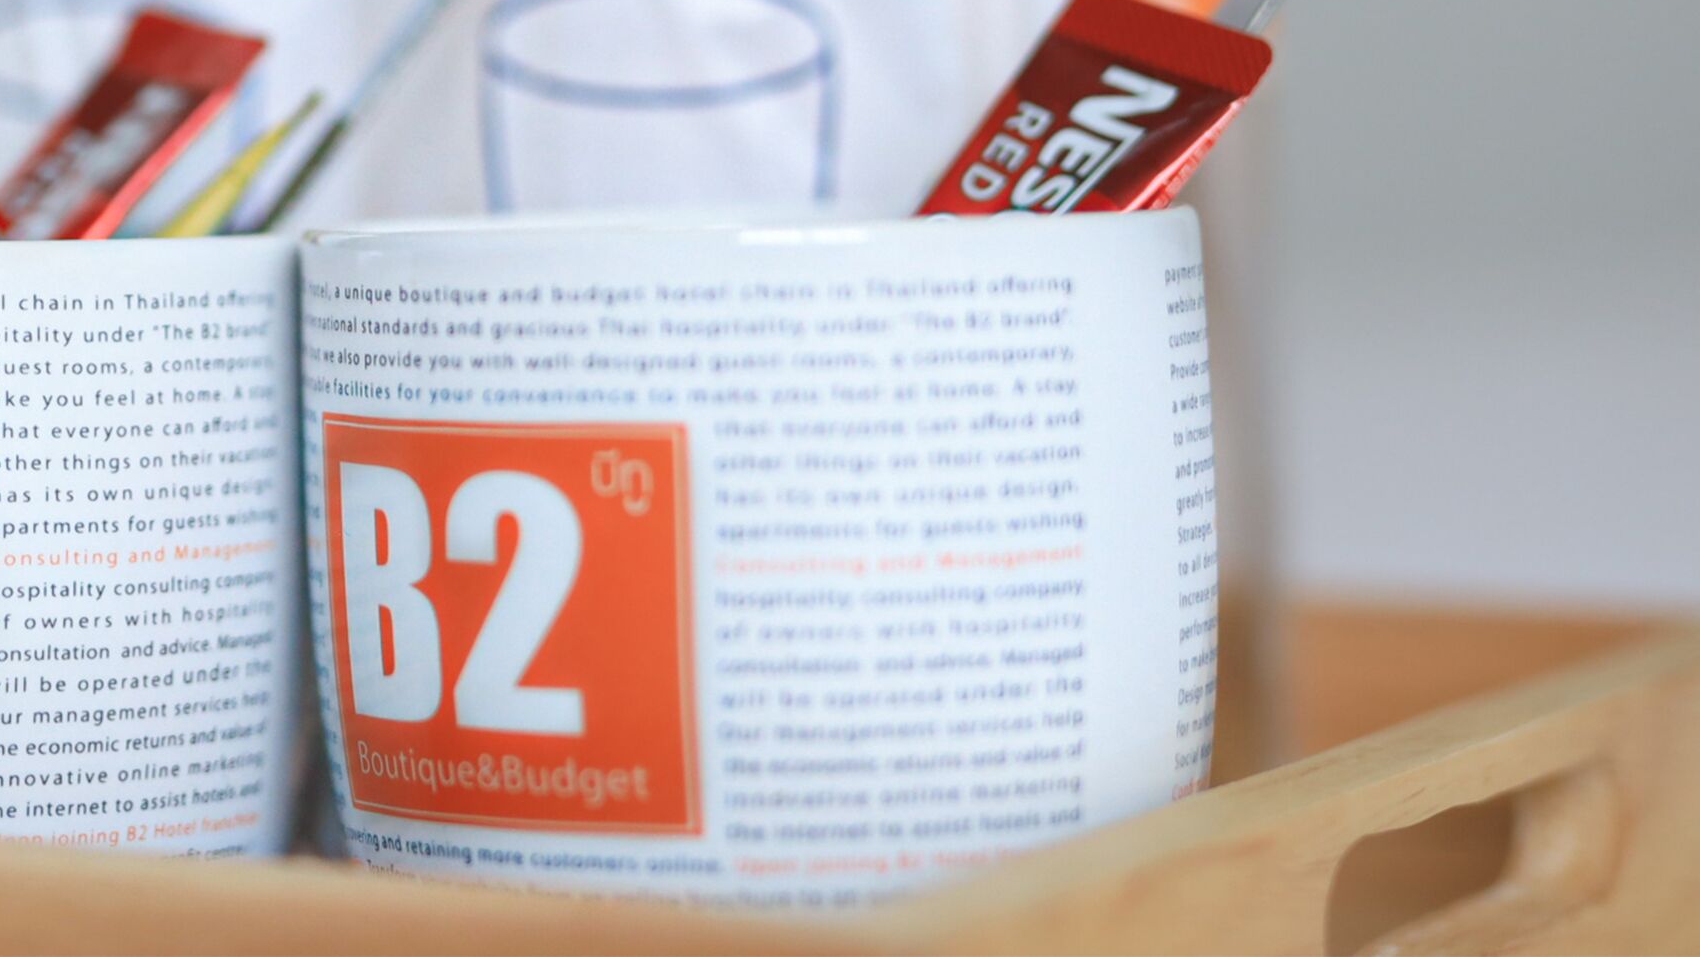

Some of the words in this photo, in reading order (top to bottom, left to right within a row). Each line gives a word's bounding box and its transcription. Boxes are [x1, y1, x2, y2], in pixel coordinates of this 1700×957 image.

[961, 101, 1054, 201] RED
[19, 295, 83, 311] chain
[95, 295, 114, 311] in
[125, 294, 209, 310] Thailand
[334, 288, 340, 300] a
[345, 286, 392, 303] unique
[400, 288, 487, 305] boutique
[500, 288, 539, 303] and
[83, 328, 144, 343] under
[201, 324, 220, 340] B2
[361, 320, 437, 336] standards
[446, 321, 481, 336] and
[63, 361, 134, 377] rooms,
[144, 361, 153, 373] a
[323, 351, 334, 363] we
[338, 348, 360, 366] also
[365, 352, 421, 370] provide
[429, 356, 460, 372] you
[472, 353, 513, 368] with
[1171, 361, 1199, 380] Provide
[43, 394, 83, 410] you
[95, 390, 136, 407] feel
[146, 390, 164, 404] at
[173, 388, 223, 403] home.
[234, 387, 242, 399] A
[333, 380, 391, 400] facilities
[397, 385, 420, 401] for
[430, 388, 473, 404] your
[1172, 399, 1177, 414] a
[1181, 396, 1198, 412] wide
[1045, 408, 1080, 427] and
[52, 423, 153, 441] everyone
[163, 422, 194, 436] can
[202, 417, 247, 433] afford
[1174, 432, 1183, 446] to
[63, 455, 131, 473] things
[140, 455, 163, 469] on
[171, 450, 211, 466] their
[996, 444, 1080, 465] vacation
[1175, 459, 1191, 479] and
[45, 487, 74, 502] its
[88, 489, 132, 501] own
[145, 484, 212, 500] unique
[1177, 490, 1204, 516] greatly
[128, 516, 155, 532] for
[164, 513, 219, 533] guests
[1007, 511, 1084, 532] wishing
[128, 546, 164, 563] and
[175, 539, 276, 559] Management
[1179, 561, 1188, 576] to
[1192, 554, 1201, 573] all
[114, 576, 211, 596] consulting
[996, 578, 1083, 599] company
[340, 461, 584, 737] B2
[1179, 586, 1210, 609] increase
[24, 614, 112, 630] owners
[125, 609, 171, 626] with
[182, 600, 275, 621] hospitality
[121, 643, 153, 658] and
[1001, 644, 1083, 666] Managed
[1179, 658, 1188, 673] to
[41, 677, 66, 692] be
[78, 671, 173, 694] operated
[183, 664, 239, 684] under
[246, 660, 271, 675] the
[1047, 675, 1082, 694] the
[1178, 679, 1203, 706] Design
[33, 703, 166, 725] management
[174, 697, 237, 716] services
[1043, 708, 1083, 728] help
[1176, 719, 1189, 738] for
[26, 737, 119, 756] economic
[126, 733, 184, 750] returns
[190, 727, 215, 744] and
[1066, 739, 1083, 759] of
[118, 765, 180, 781] online
[188, 751, 265, 775] marketing
[1175, 746, 1199, 770] Social
[357, 740, 648, 808] Boutique&Budget
[26, 802, 107, 817] internet
[116, 799, 133, 813] to
[140, 793, 187, 810] assist
[192, 786, 234, 804] hotels
[1049, 807, 1080, 826] and
[127, 826, 147, 841] B2
[155, 820, 196, 838] Hotel
[382, 836, 402, 852] and
[406, 840, 472, 865] retaining
[478, 847, 523, 865] more
